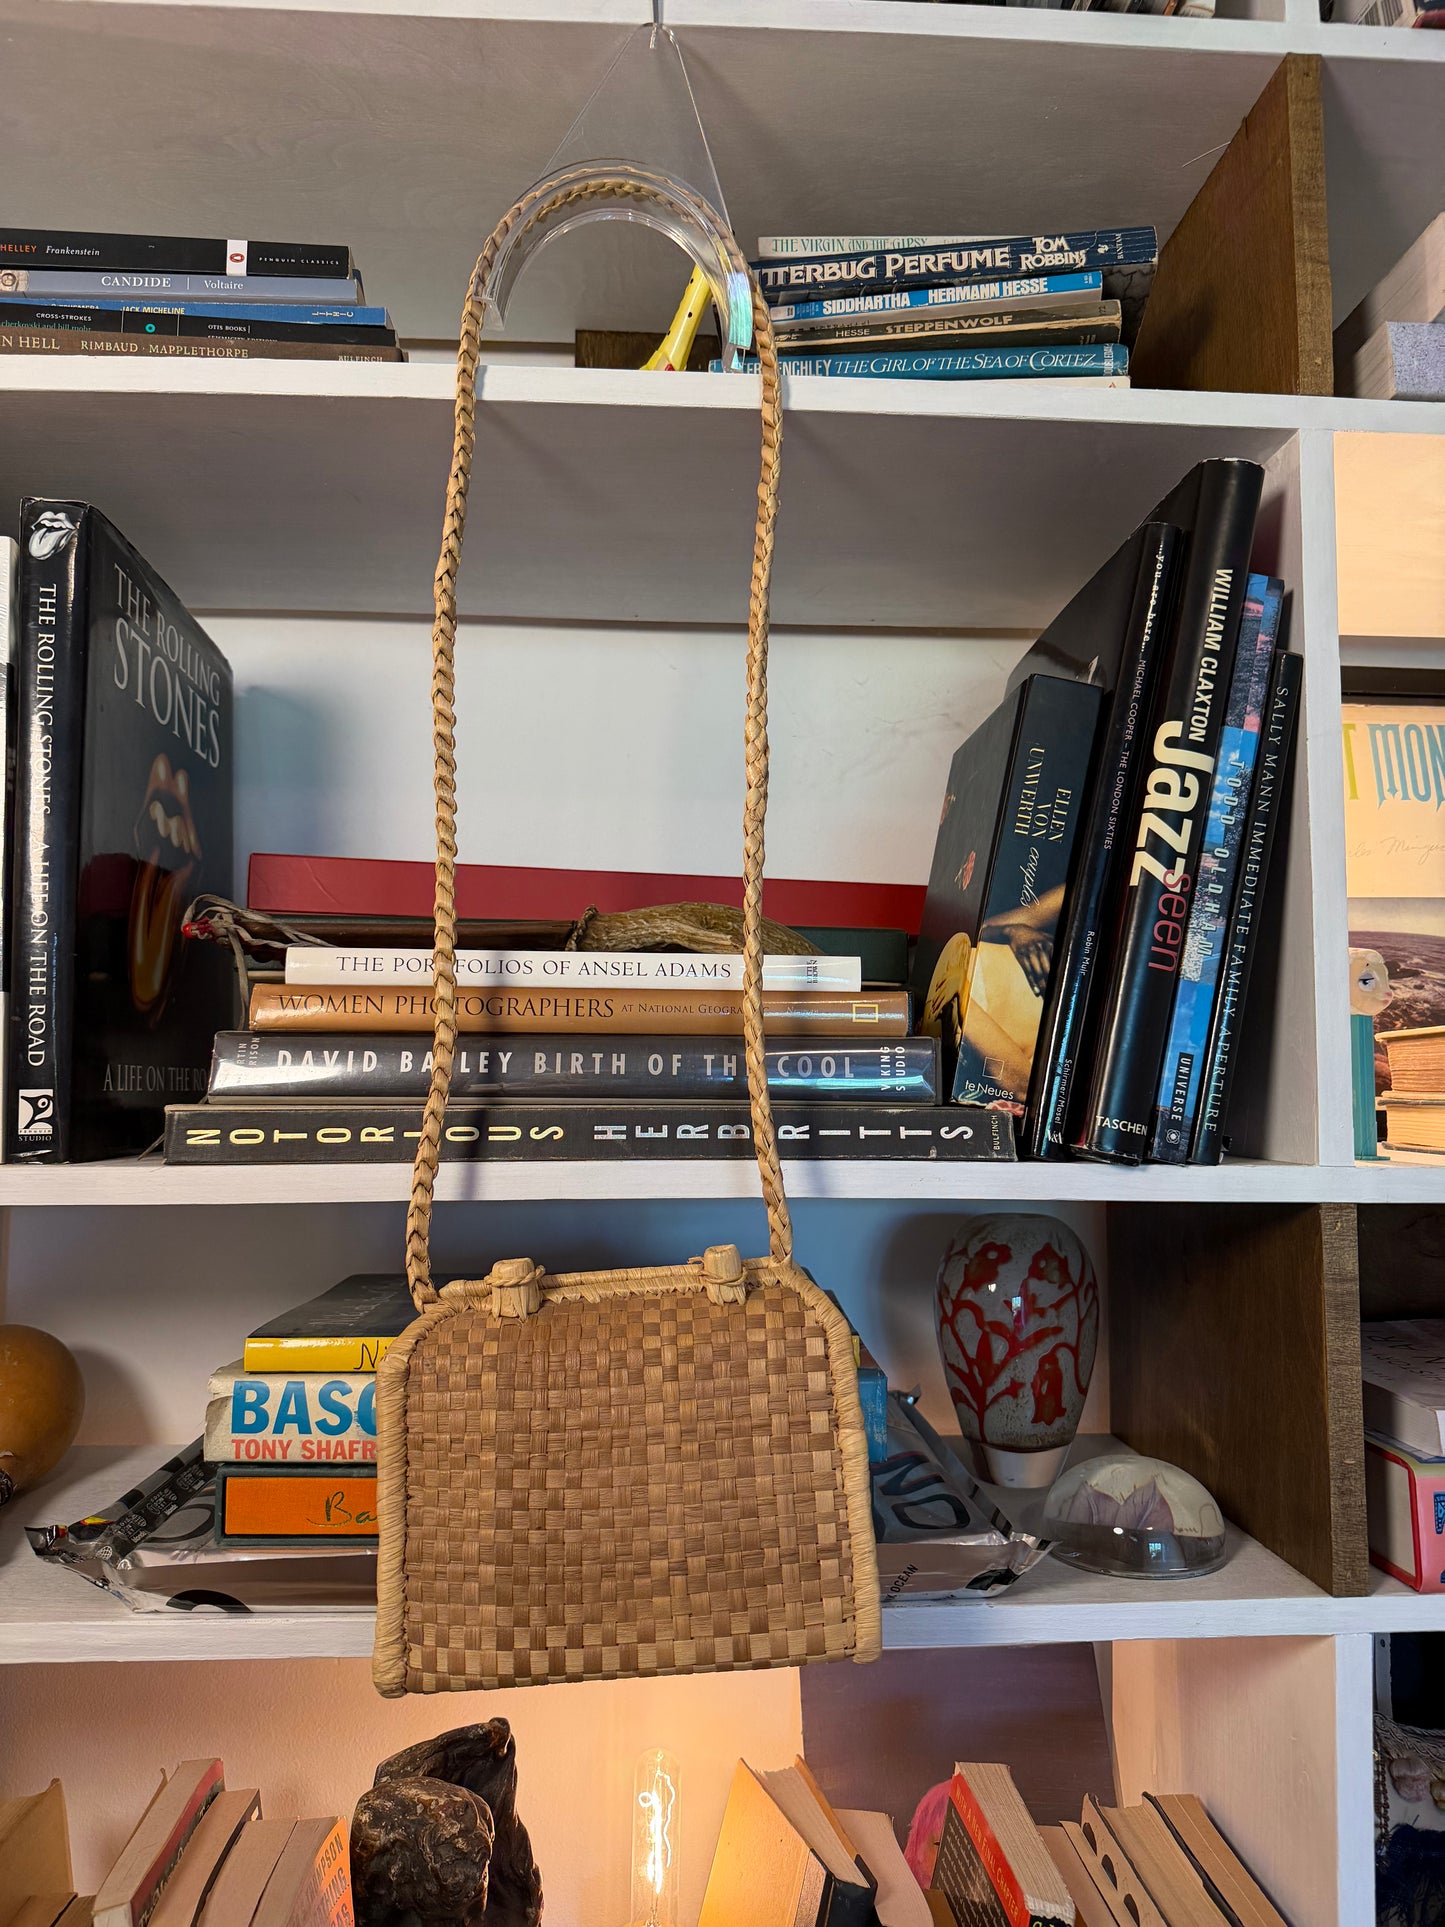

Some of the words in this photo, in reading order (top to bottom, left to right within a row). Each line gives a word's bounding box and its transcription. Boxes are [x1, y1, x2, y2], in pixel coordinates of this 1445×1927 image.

[45, 245, 100, 256] Frankenstein
[772, 238, 798, 252] THE
[800, 238, 845, 252] VIRGIN
[1018, 249, 1088, 271] ROBBINS
[1031, 236, 1070, 254] TOM
[101, 276, 171, 288] CANDIDE
[204, 280, 244, 290] Voltaire
[753, 256, 878, 287] ITTERBUG
[885, 245, 1011, 280] PERFUME
[36, 312, 92, 322] CROSS-STROKES
[822, 292, 911, 316] SIDDHARTHA
[928, 282, 1000, 305] HERMANN
[1002, 277, 1049, 298] HESSE
[18, 336, 61, 350] HELL
[80, 340, 139, 353] RIMBAUD
[149, 344, 249, 358] MAPPLETHORPE
[835, 328, 870, 338] HESSE
[885, 315, 1013, 334] STEPPENWOLF
[834, 360, 870, 374] THE
[870, 356, 912, 374] GIRL
[912, 357, 938, 372] OF
[938, 356, 972, 372] THE
[973, 352, 1004, 370] SEA
[1004, 354, 1029, 369] OF
[1029, 350, 1097, 372] CORTEZ
[38, 583, 58, 626] THE
[1203, 568, 1234, 652] WILLIAM
[114, 562, 151, 637] THE
[156, 609, 221, 708] ROLLING
[36, 632, 56, 727] ROLLING
[114, 617, 221, 770] STONES
[1132, 659, 1147, 700] MICHAEL
[1188, 656, 1218, 743] CLAXTON
[1124, 702, 1139, 741] COOPER
[1268, 686, 1289, 746] SALLY
[33, 734, 52, 816] STONES
[1119, 750, 1130, 769] THE
[1014, 747, 1045, 836] UNWERTH
[1111, 770, 1126, 814] LONDON
[1220, 760, 1246, 826] TODD
[1257, 752, 1278, 814] MANN
[1031, 802, 1052, 840] VON
[1048, 788, 1072, 844] ELLEN
[1129, 720, 1216, 894] Jazz
[31, 838, 50, 854] A
[1104, 816, 1117, 850] SIXTIES
[1020, 846, 1040, 908] couples
[1236, 822, 1268, 936] IMMEDIATE
[1148, 868, 1192, 973] seen
[1197, 846, 1230, 956] OLDHAM
[30, 910, 49, 945] ON
[1084, 930, 1096, 954] Robin
[28, 952, 48, 997] THE
[336, 956, 384, 973] THE
[393, 956, 534, 976] PORFOLIOS
[542, 959, 571, 976] OF
[578, 960, 648, 978] ANSEL
[655, 962, 732, 979] ADAMS
[1080, 956, 1091, 976] Muir
[1223, 943, 1247, 1018] FAMILY
[278, 994, 384, 1015] WOMEN
[28, 1003, 47, 1067] ROAD
[102, 1064, 114, 1092] A
[117, 1065, 144, 1092] LIFE
[146, 1065, 166, 1092] ON
[168, 1066, 191, 1092] THE
[192, 1067, 209, 1092] RO
[278, 1050, 379, 1074] DAVID
[400, 1050, 513, 1074] BALEY
[534, 1052, 627, 1076] BIRTH
[647, 1054, 683, 1076] OF
[703, 1054, 748, 1076] TH
[777, 1056, 856, 1078] COOL
[880, 1046, 891, 1091] VKING
[894, 1046, 906, 1092] SUDIO
[1204, 1025, 1232, 1132] APERTURE
[1054, 1058, 1073, 1125] Schirmer/Mosel
[1171, 1056, 1192, 1122] UNIVERSE
[593, 1124, 750, 1142] HERB
[778, 1124, 974, 1142] RITTS
[991, 1114, 1001, 1151] BULFINCH
[1095, 1114, 1148, 1136] TASCHEN
[231, 1438, 294, 1460] TONY
[890, 1564, 919, 1593] OCEAN
